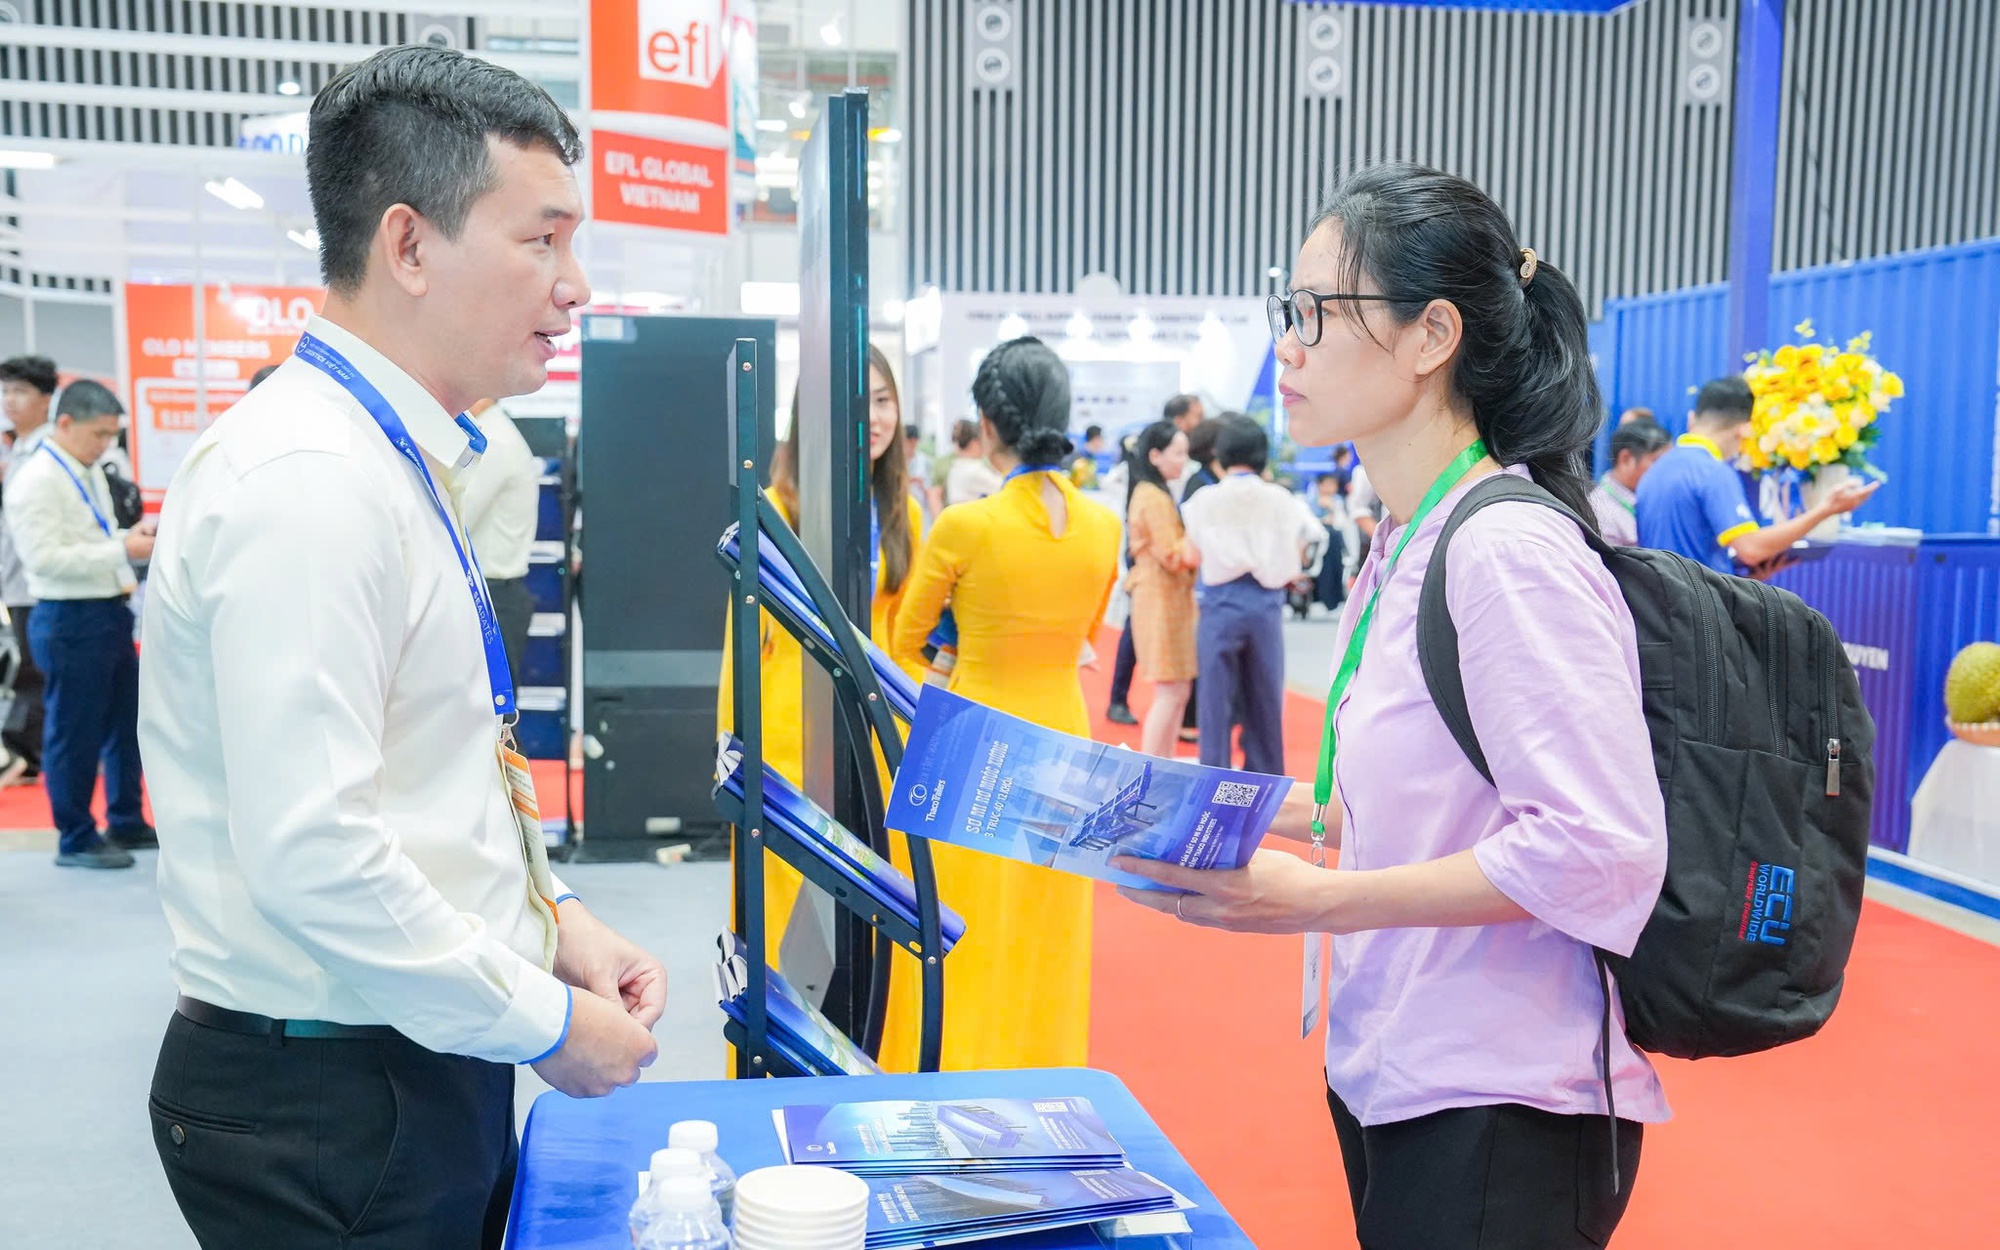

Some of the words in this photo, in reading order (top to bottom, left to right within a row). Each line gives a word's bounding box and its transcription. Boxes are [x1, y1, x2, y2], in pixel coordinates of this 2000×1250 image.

[647, 21, 710, 80] efl
[604, 150, 640, 177] EFL
[641, 156, 714, 188] GLOBAL
[619, 182, 700, 213] VIETNAM
[473, 590, 494, 645] SEARATES
[975, 788, 992, 803] RƠ
[979, 766, 1000, 791] MOÓC
[925, 779, 947, 821] ThacoTrailers
[970, 803, 987, 818] MI
[965, 816, 982, 834] SƠ
[1746, 863, 1770, 942] WORLDWIDE
[1760, 865, 1795, 945] ECU
